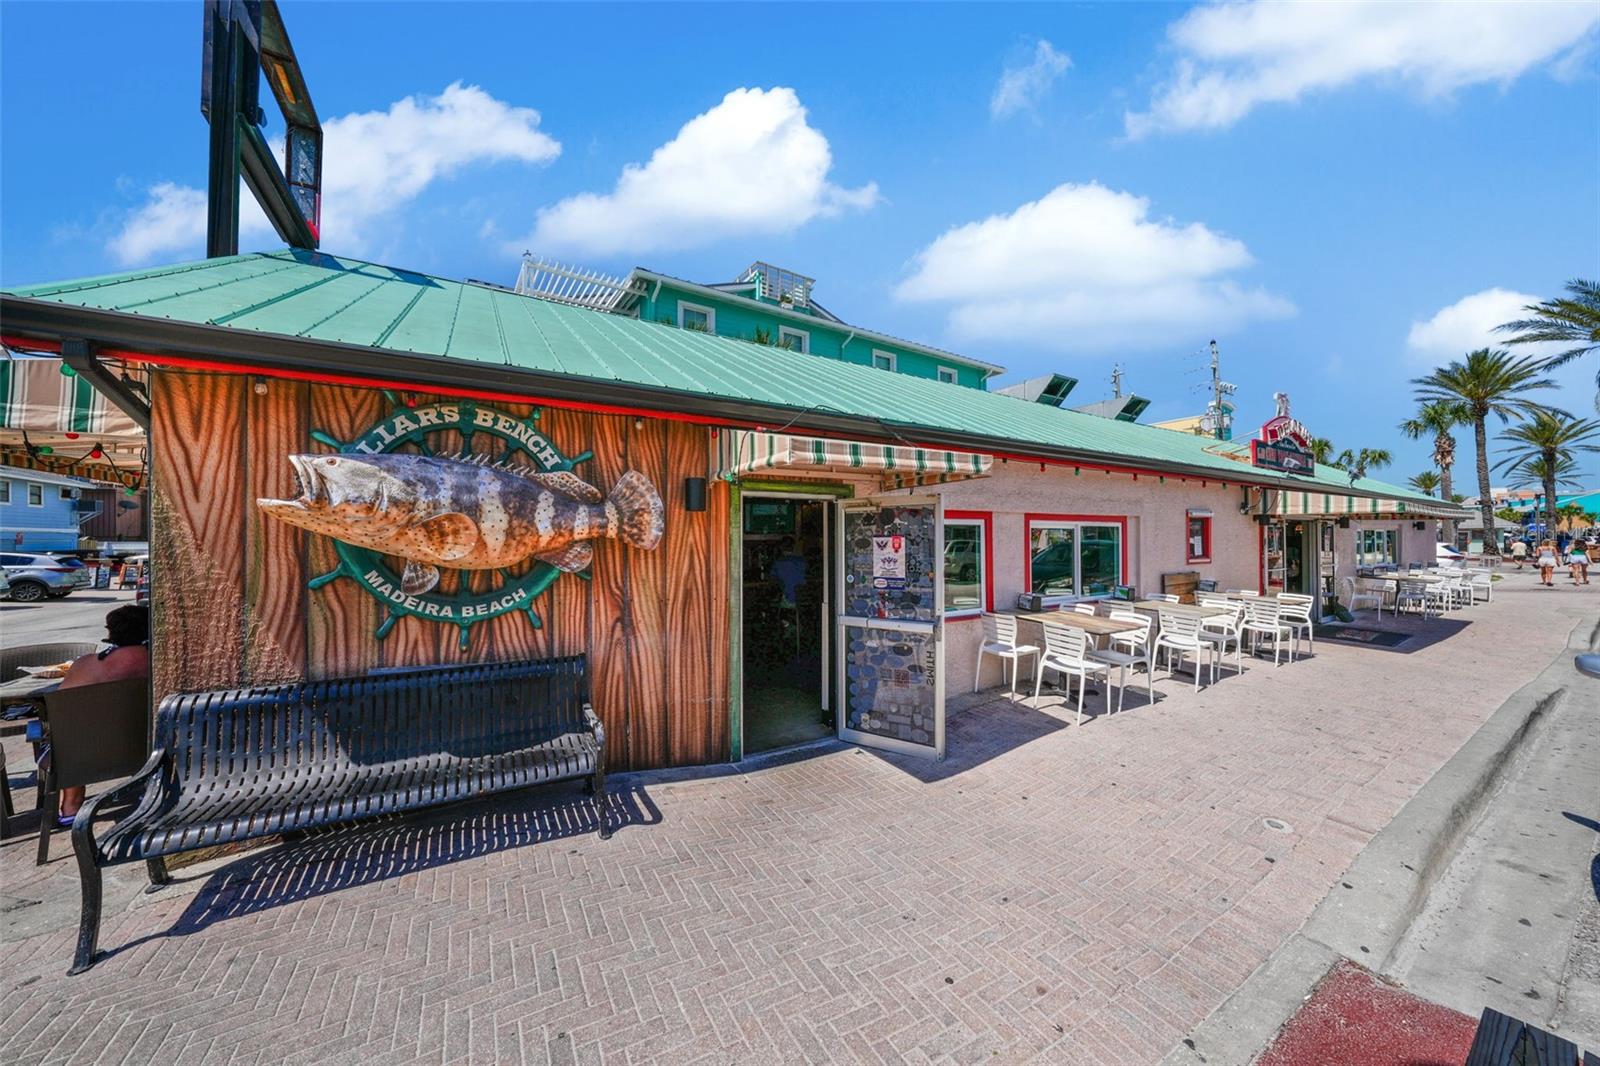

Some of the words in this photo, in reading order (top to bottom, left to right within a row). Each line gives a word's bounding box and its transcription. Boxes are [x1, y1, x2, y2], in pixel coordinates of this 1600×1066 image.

[356, 403, 460, 454] LIAR'S
[473, 408, 562, 470] BENCH
[363, 570, 453, 617] MADEIRA
[461, 588, 527, 617] BEACH
